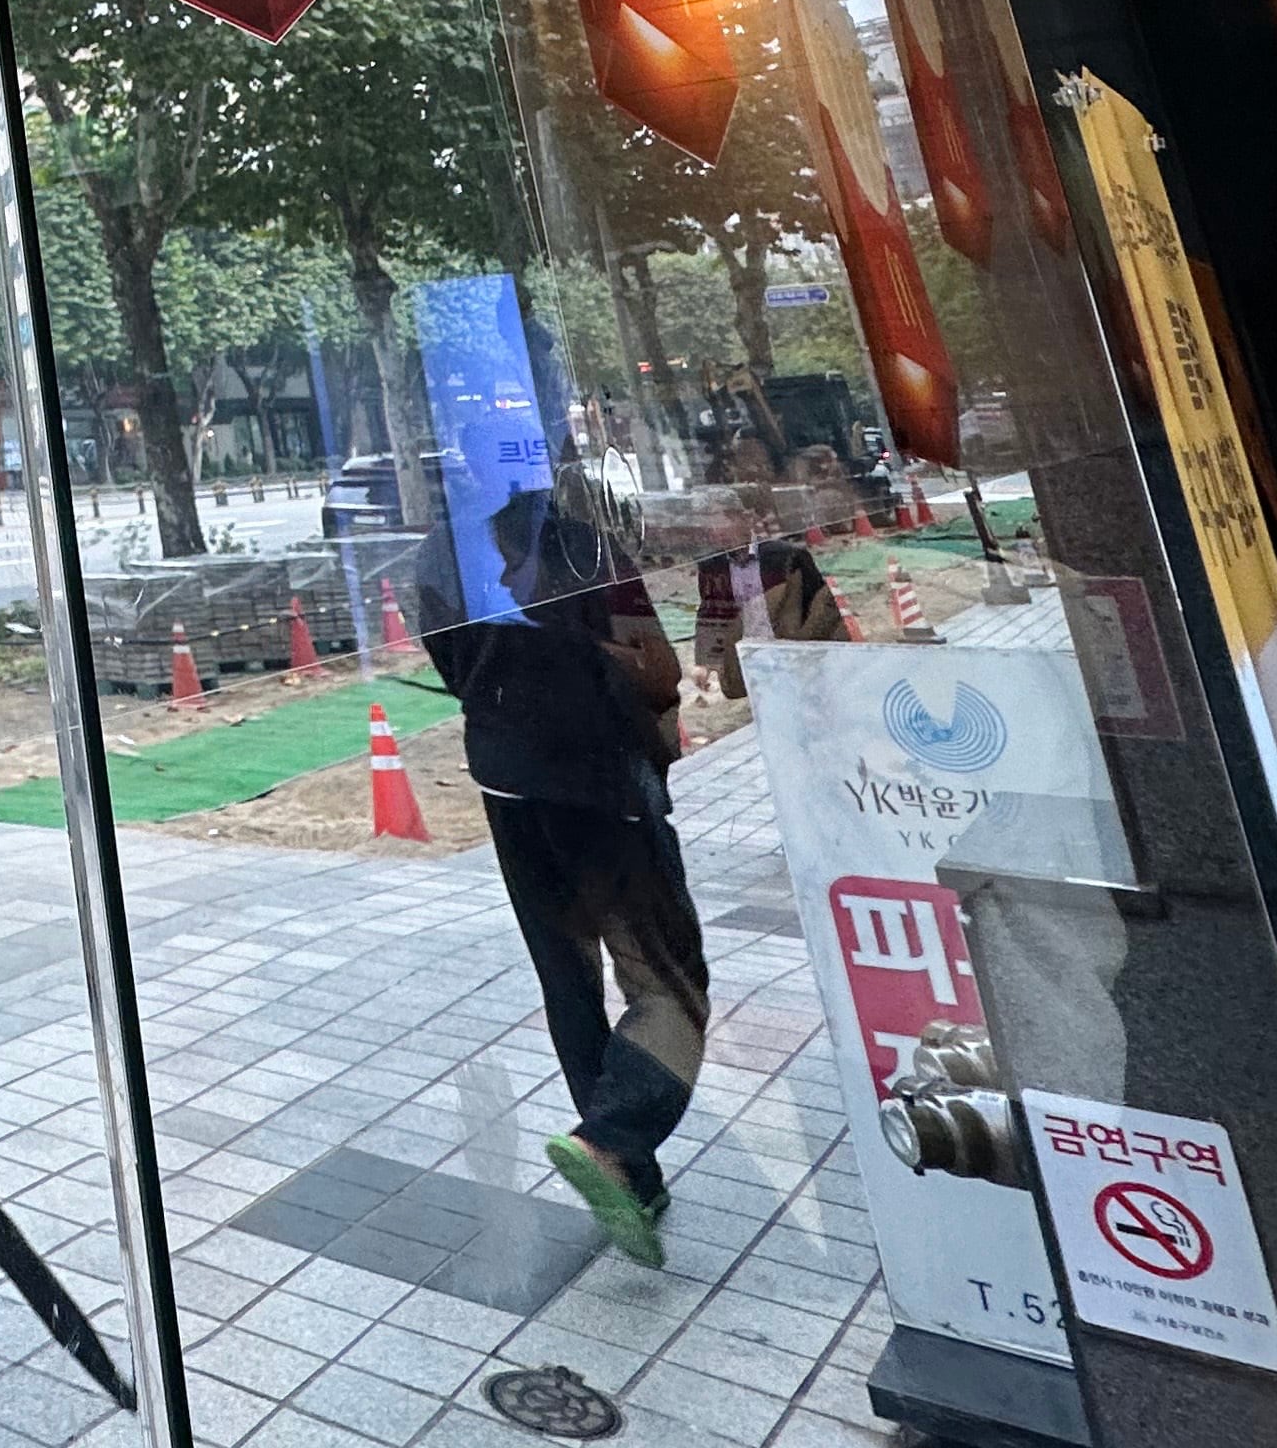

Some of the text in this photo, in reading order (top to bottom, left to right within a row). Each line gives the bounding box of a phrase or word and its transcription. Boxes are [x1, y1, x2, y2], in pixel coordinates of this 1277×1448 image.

[838, 893, 974, 1006] 피
[1043, 1113, 1228, 1186] 금연구역
[1201, 1299, 1238, 1319] 과태료
[1243, 1309, 1272, 1328] 부과
